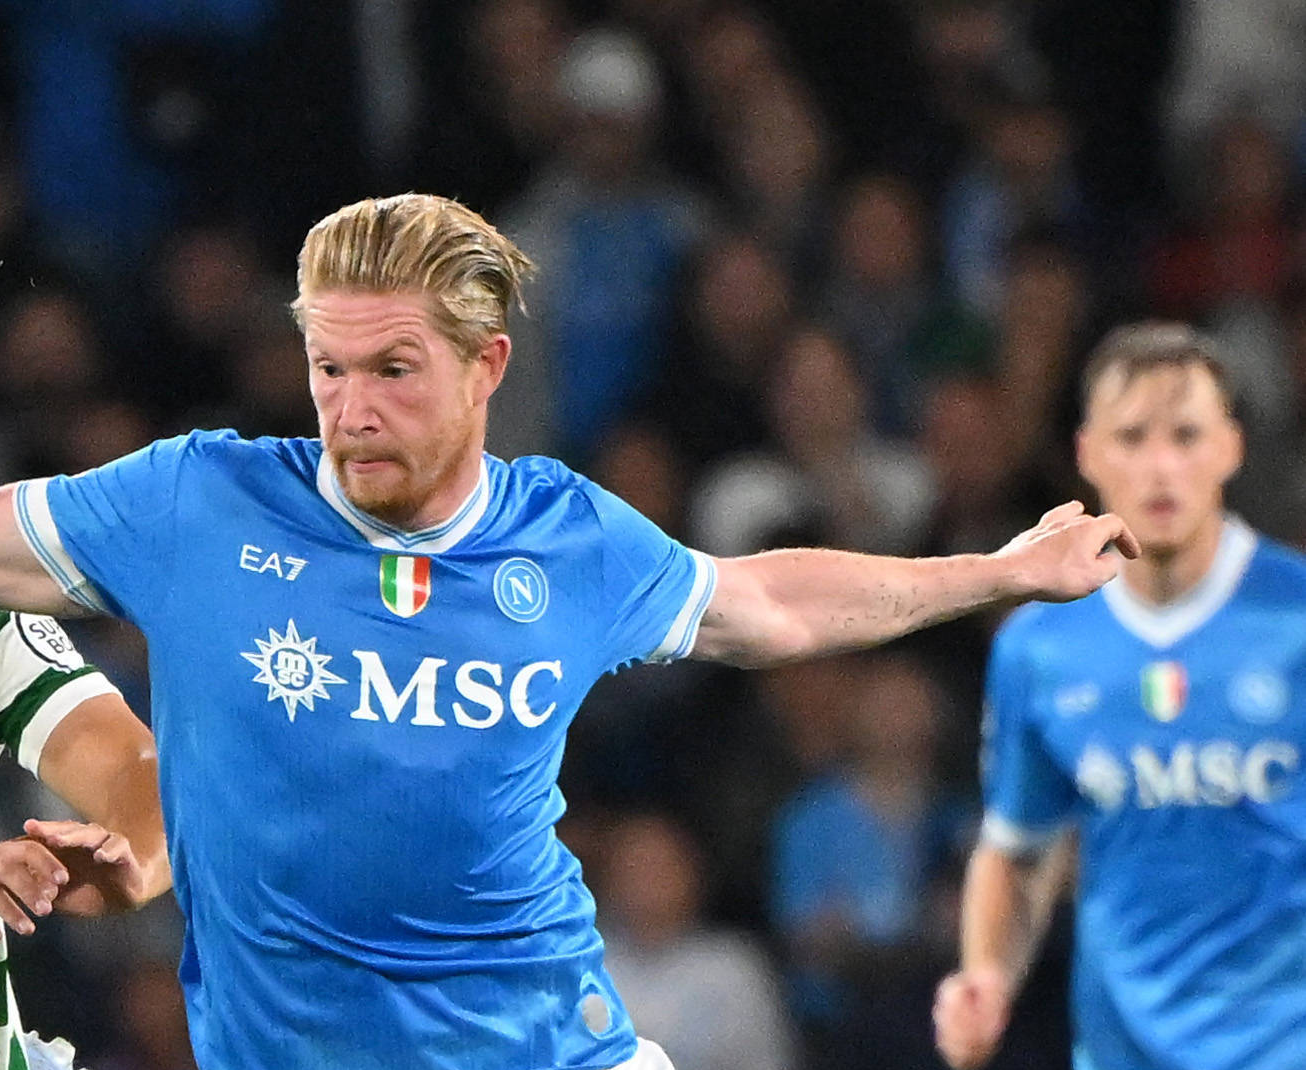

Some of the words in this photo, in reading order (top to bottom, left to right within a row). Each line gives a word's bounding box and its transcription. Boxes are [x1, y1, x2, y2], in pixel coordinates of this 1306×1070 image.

[240, 544, 310, 581] EA7
[350, 650, 563, 729] MSC
[1129, 740, 1298, 809] MSC
